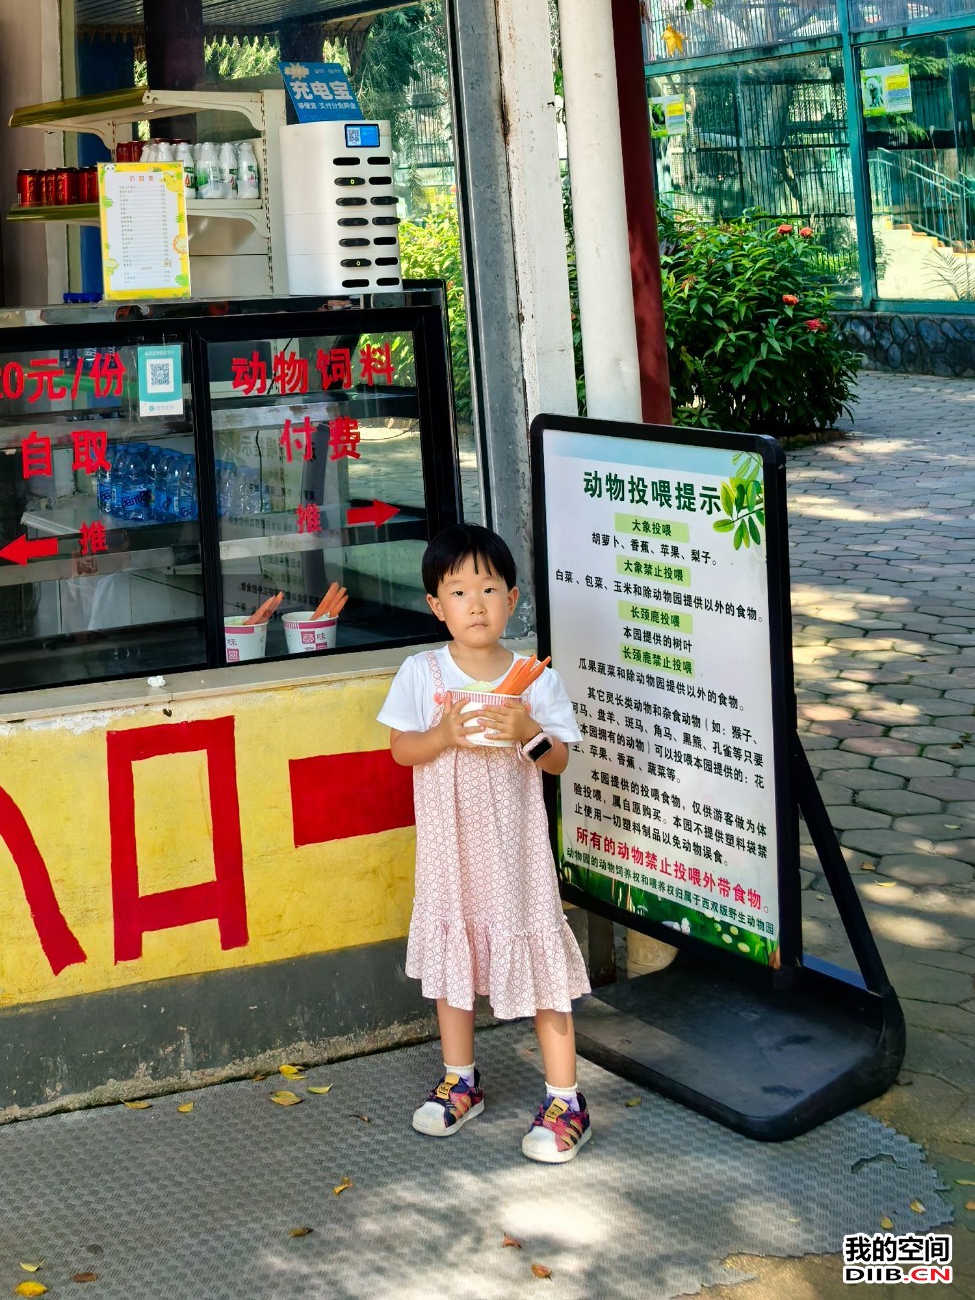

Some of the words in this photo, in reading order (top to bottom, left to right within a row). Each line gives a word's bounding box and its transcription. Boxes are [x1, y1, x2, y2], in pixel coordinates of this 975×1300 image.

[290, 81, 353, 100] 充电宝
[231, 342, 395, 396] 动物饲料
[22, 430, 112, 478] 自取
[279, 416, 362, 462] 付费
[582, 470, 722, 515] 动物投喂提示
[78, 520, 108, 555] 推
[296, 503, 323, 534] 推
[631, 519, 672, 537] 大象投喂
[592, 532, 717, 566] 胡萝卜、香蕉、苹果、梨子。
[624, 560, 684, 582] 大象禁止投喂
[555, 569, 763, 623] 白菜、包菜、玉米和除动物园提供以外的食物。
[630, 606, 680, 628] 长颈鹿投喂
[623, 626, 693, 653] 本园提供的树叶
[622, 648, 693, 675] 长颈鹿禁止投喂
[578, 657, 744, 712] 瓜果蔬菜和除动物园提供以外的食物。
[578, 722, 765, 789] 本园拥有的动物）可以投喂本园提供的：花
[574, 803, 729, 867] 止使用一切塑料制品以免动物误食。
[576, 826, 768, 914] 所有的动物禁止投喂外带食物。
